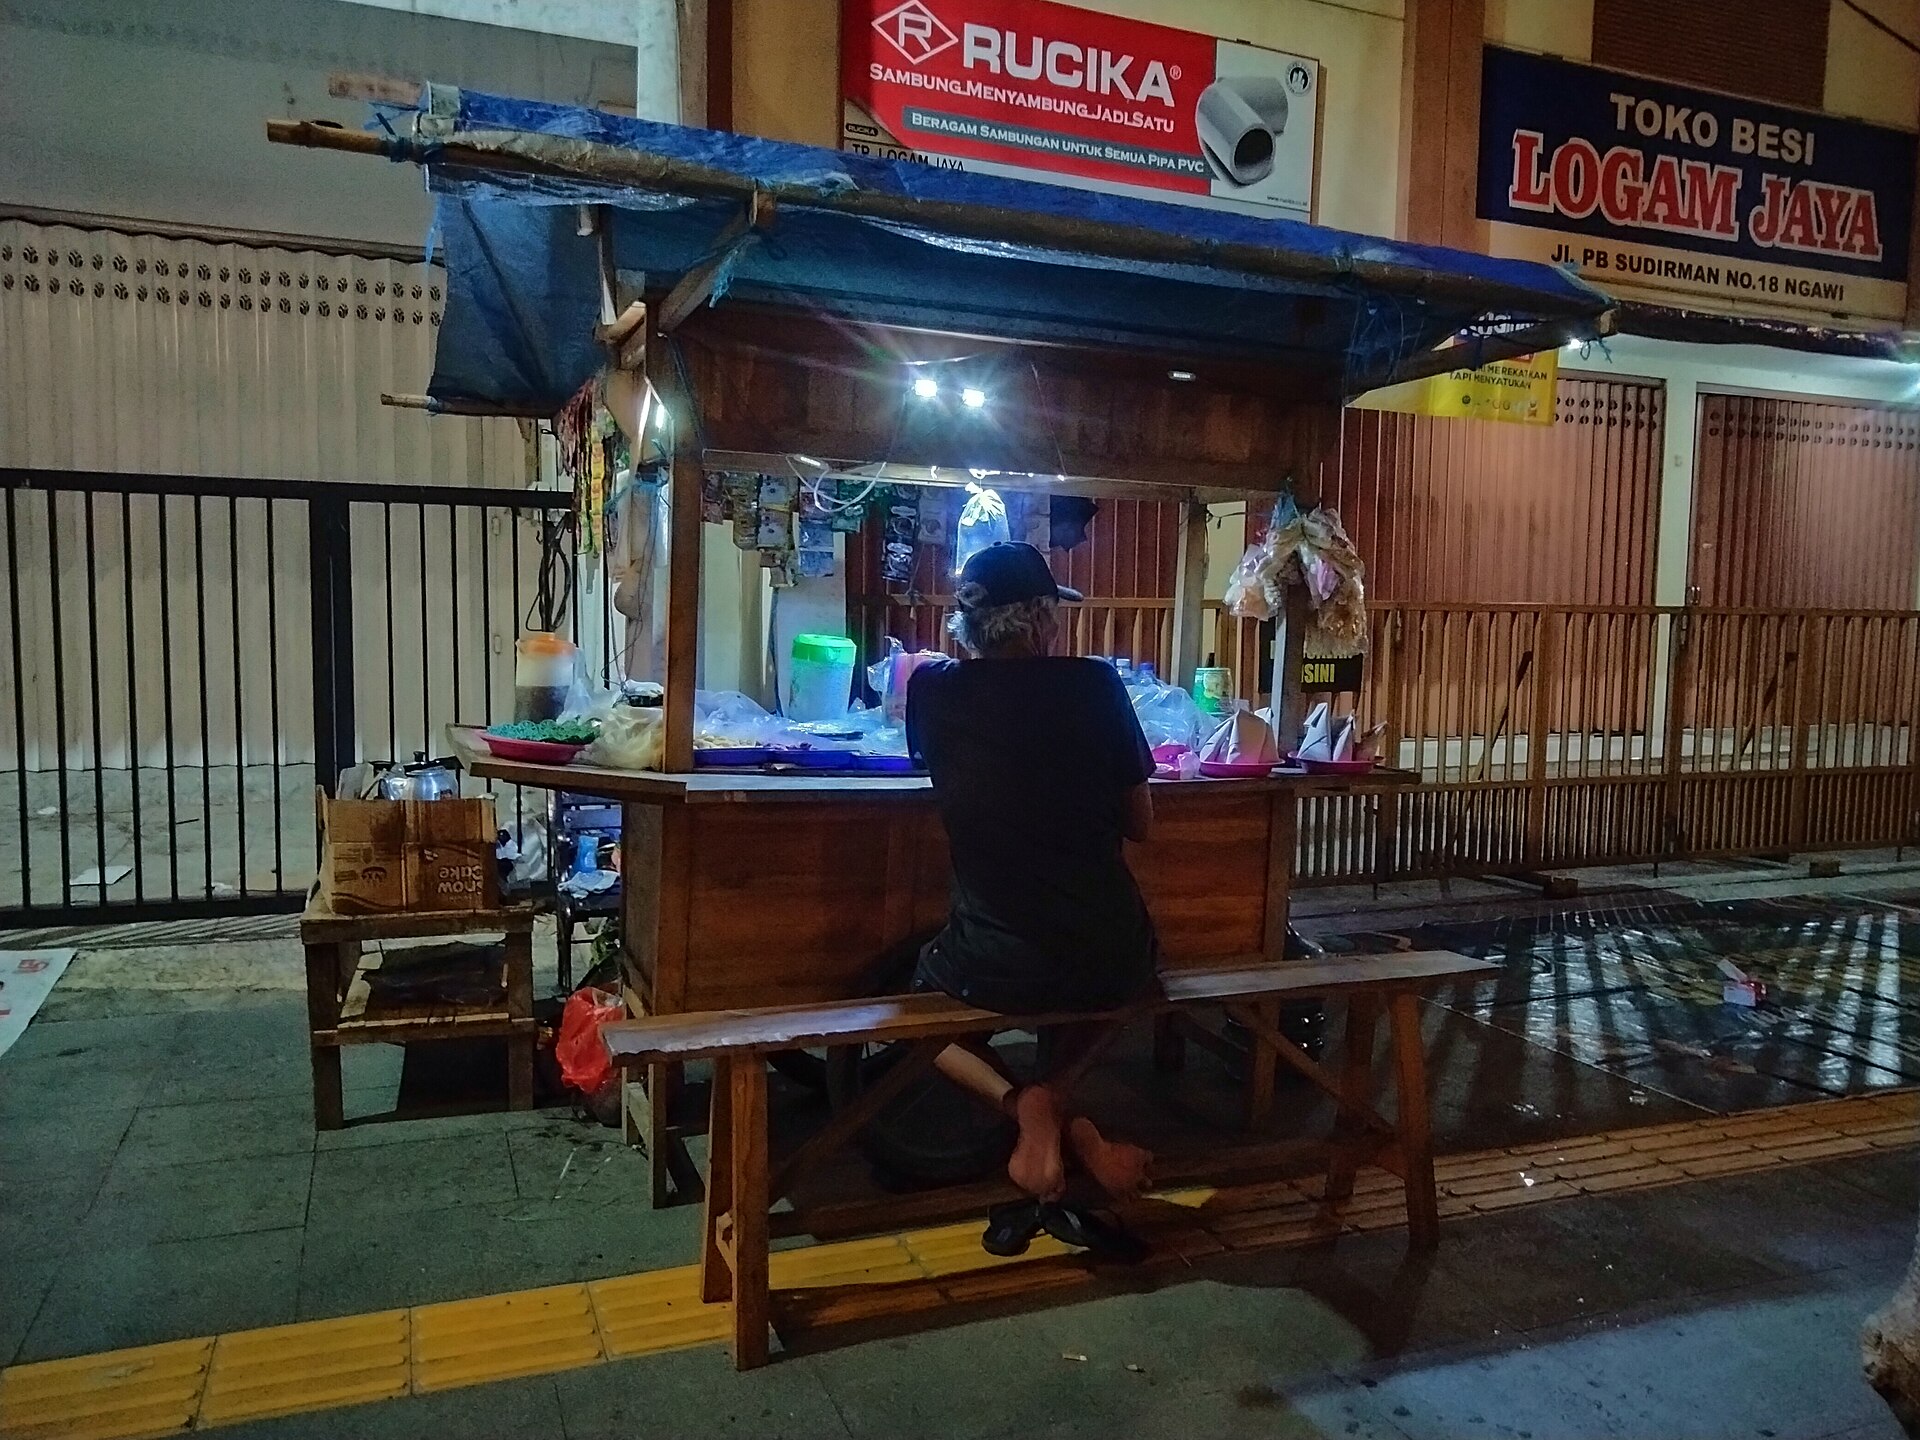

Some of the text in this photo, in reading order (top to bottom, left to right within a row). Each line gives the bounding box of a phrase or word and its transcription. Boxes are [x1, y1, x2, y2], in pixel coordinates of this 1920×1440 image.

[898, 11, 932, 51] R
[963, 22, 1175, 107] RUCIKA
[912, 112, 1205, 172] BERAGAM SAMBUNGAN UNTUK SEMUA PIPA PVC
[1610, 93, 1816, 165] TOKO BESI
[1509, 129, 1884, 262] LOGAM JAYA
[1583, 248, 1609, 268] PB
[1616, 253, 1720, 285] SUDIRMAN
[1726, 270, 1779, 293] NO.18
[1785, 278, 1844, 301] NGAWI
[1487, 364, 1548, 380] MEREKATKAN
